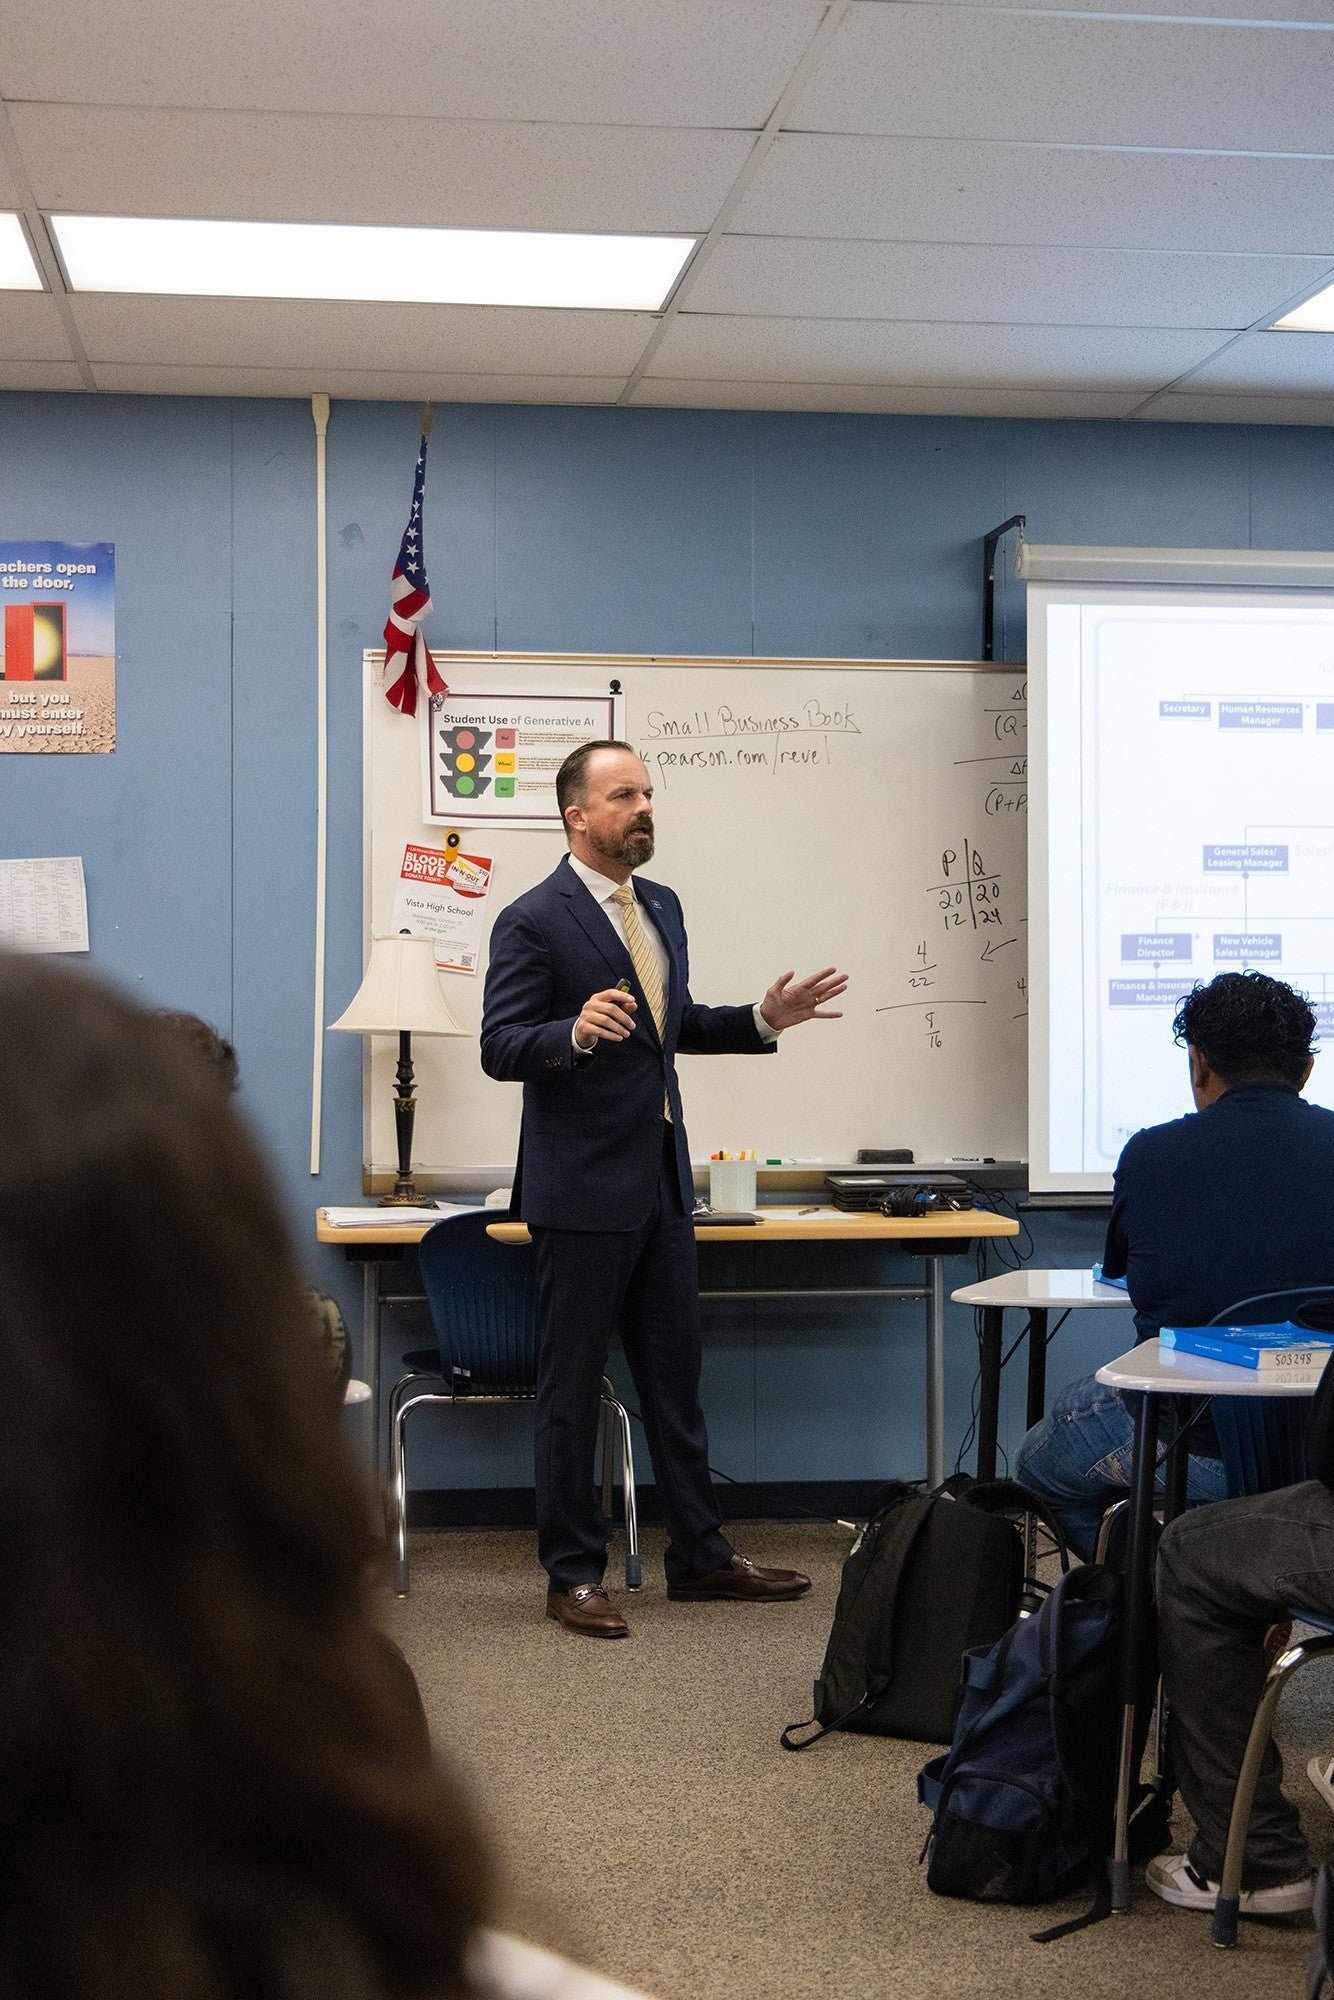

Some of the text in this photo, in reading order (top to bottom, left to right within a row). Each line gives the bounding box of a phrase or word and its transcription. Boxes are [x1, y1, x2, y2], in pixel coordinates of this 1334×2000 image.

[56, 563, 97, 576] open
[2, 576, 75, 590] the door,
[9, 691, 70, 707] but you
[41, 710, 84, 719] enter
[1163, 703, 1206, 714] Secretary
[1221, 704, 1301, 714] Human Resources
[443, 714, 595, 727] Student Use of Generative AI
[647, 699, 860, 739] Small Business Book
[1240, 715, 1282, 727] Manager
[17, 722, 87, 738] yourself.
[1213, 847, 1277, 857] General Sales/
[405, 851, 447, 867] BLOOD
[942, 849, 986, 877] P Q
[1207, 858, 1284, 868] Leasing Manager
[402, 861, 446, 878] DRIVE
[1105, 883, 1159, 895] Finance
[939, 883, 1000, 909] 20 20
[406, 898, 474, 917] Vista High School
[944, 908, 1003, 930] 12 24
[1138, 936, 1174, 945] Finance
[1220, 936, 1274, 945] New Vehicle
[917, 940, 928, 964] 4
[1137, 948, 1175, 957] Director
[1215, 948, 1280, 959] Sales Manager
[908, 977, 935, 988] 22
[1111, 981, 1193, 990] Finance & Insuran
[1136, 994, 1177, 1003] Manager
[930, 1036, 942, 1048] 16
[1275, 1353, 1312, 1366] 503298
